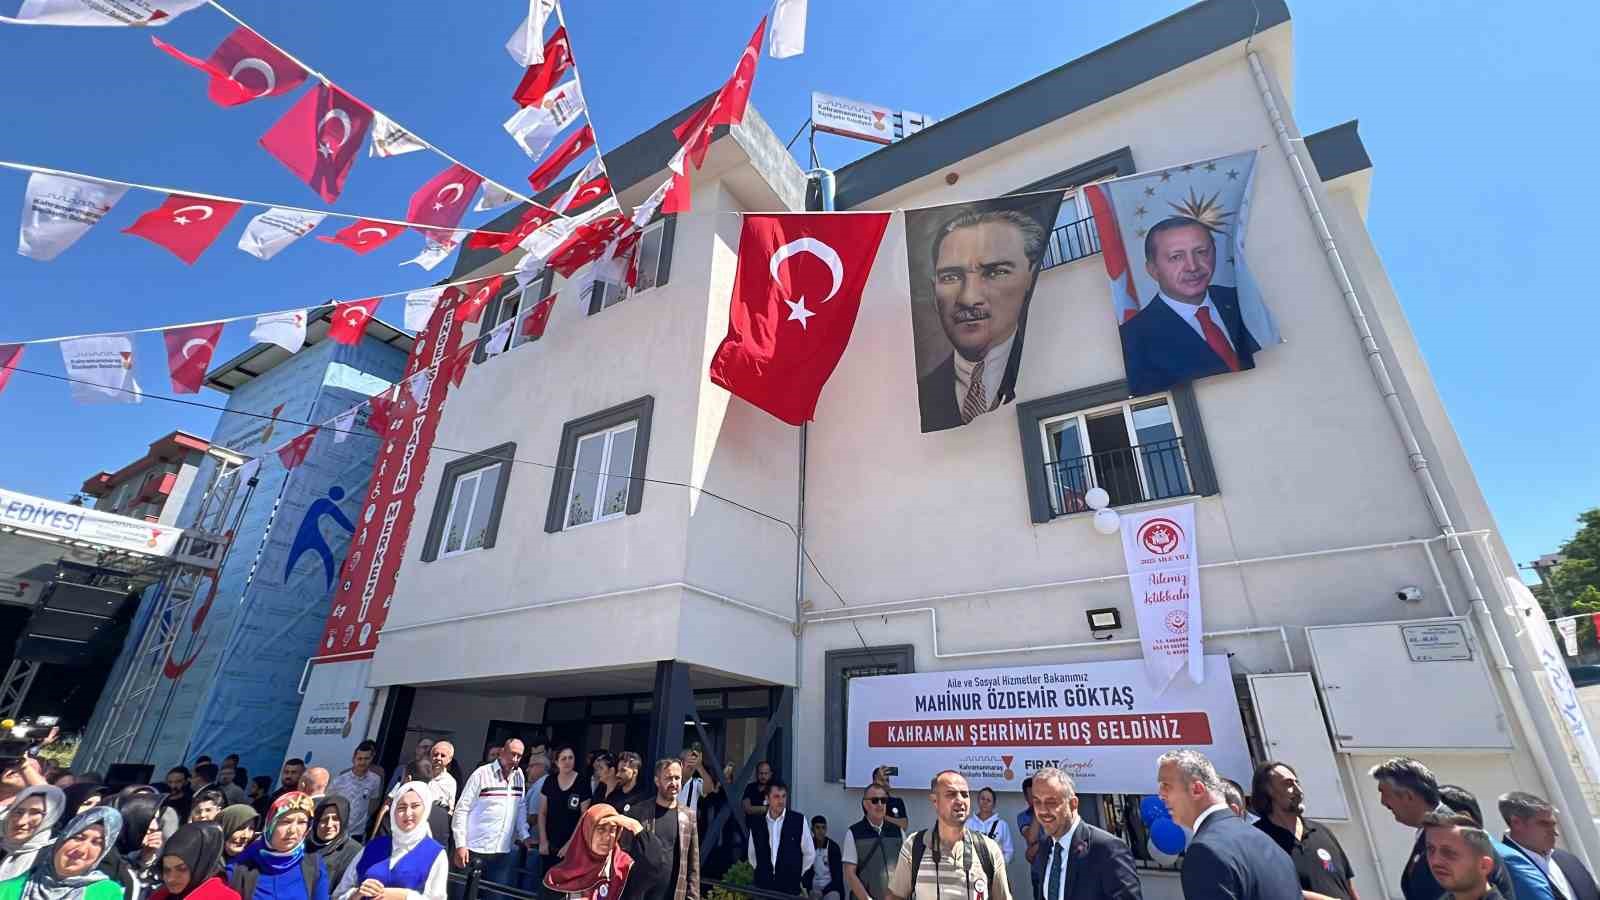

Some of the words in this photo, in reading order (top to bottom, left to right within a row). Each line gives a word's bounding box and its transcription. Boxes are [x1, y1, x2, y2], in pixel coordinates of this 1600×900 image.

[394, 415, 425, 494] YAŞAM
[0, 500, 86, 532] EDİYESİ
[359, 501, 401, 622] MERKEZİ
[947, 678, 961, 688] Aile
[963, 679, 973, 688] ve
[974, 676, 1001, 689] Sosyal
[1002, 674, 1041, 686] Hizmetler
[1043, 672, 1089, 684] Bakanımız
[915, 691, 982, 712] MAHİNUR
[987, 686, 1058, 710] ÖZDEMİR
[1064, 684, 1134, 710] GÖKTAŞ
[888, 725, 964, 743] KAHRAMAN
[969, 719, 1053, 745] ŞEHRİMİZE
[1058, 721, 1092, 745] HOŞ
[1098, 715, 1181, 741] GELDİNİZ
[1025, 760, 1059, 770] FIRAT
